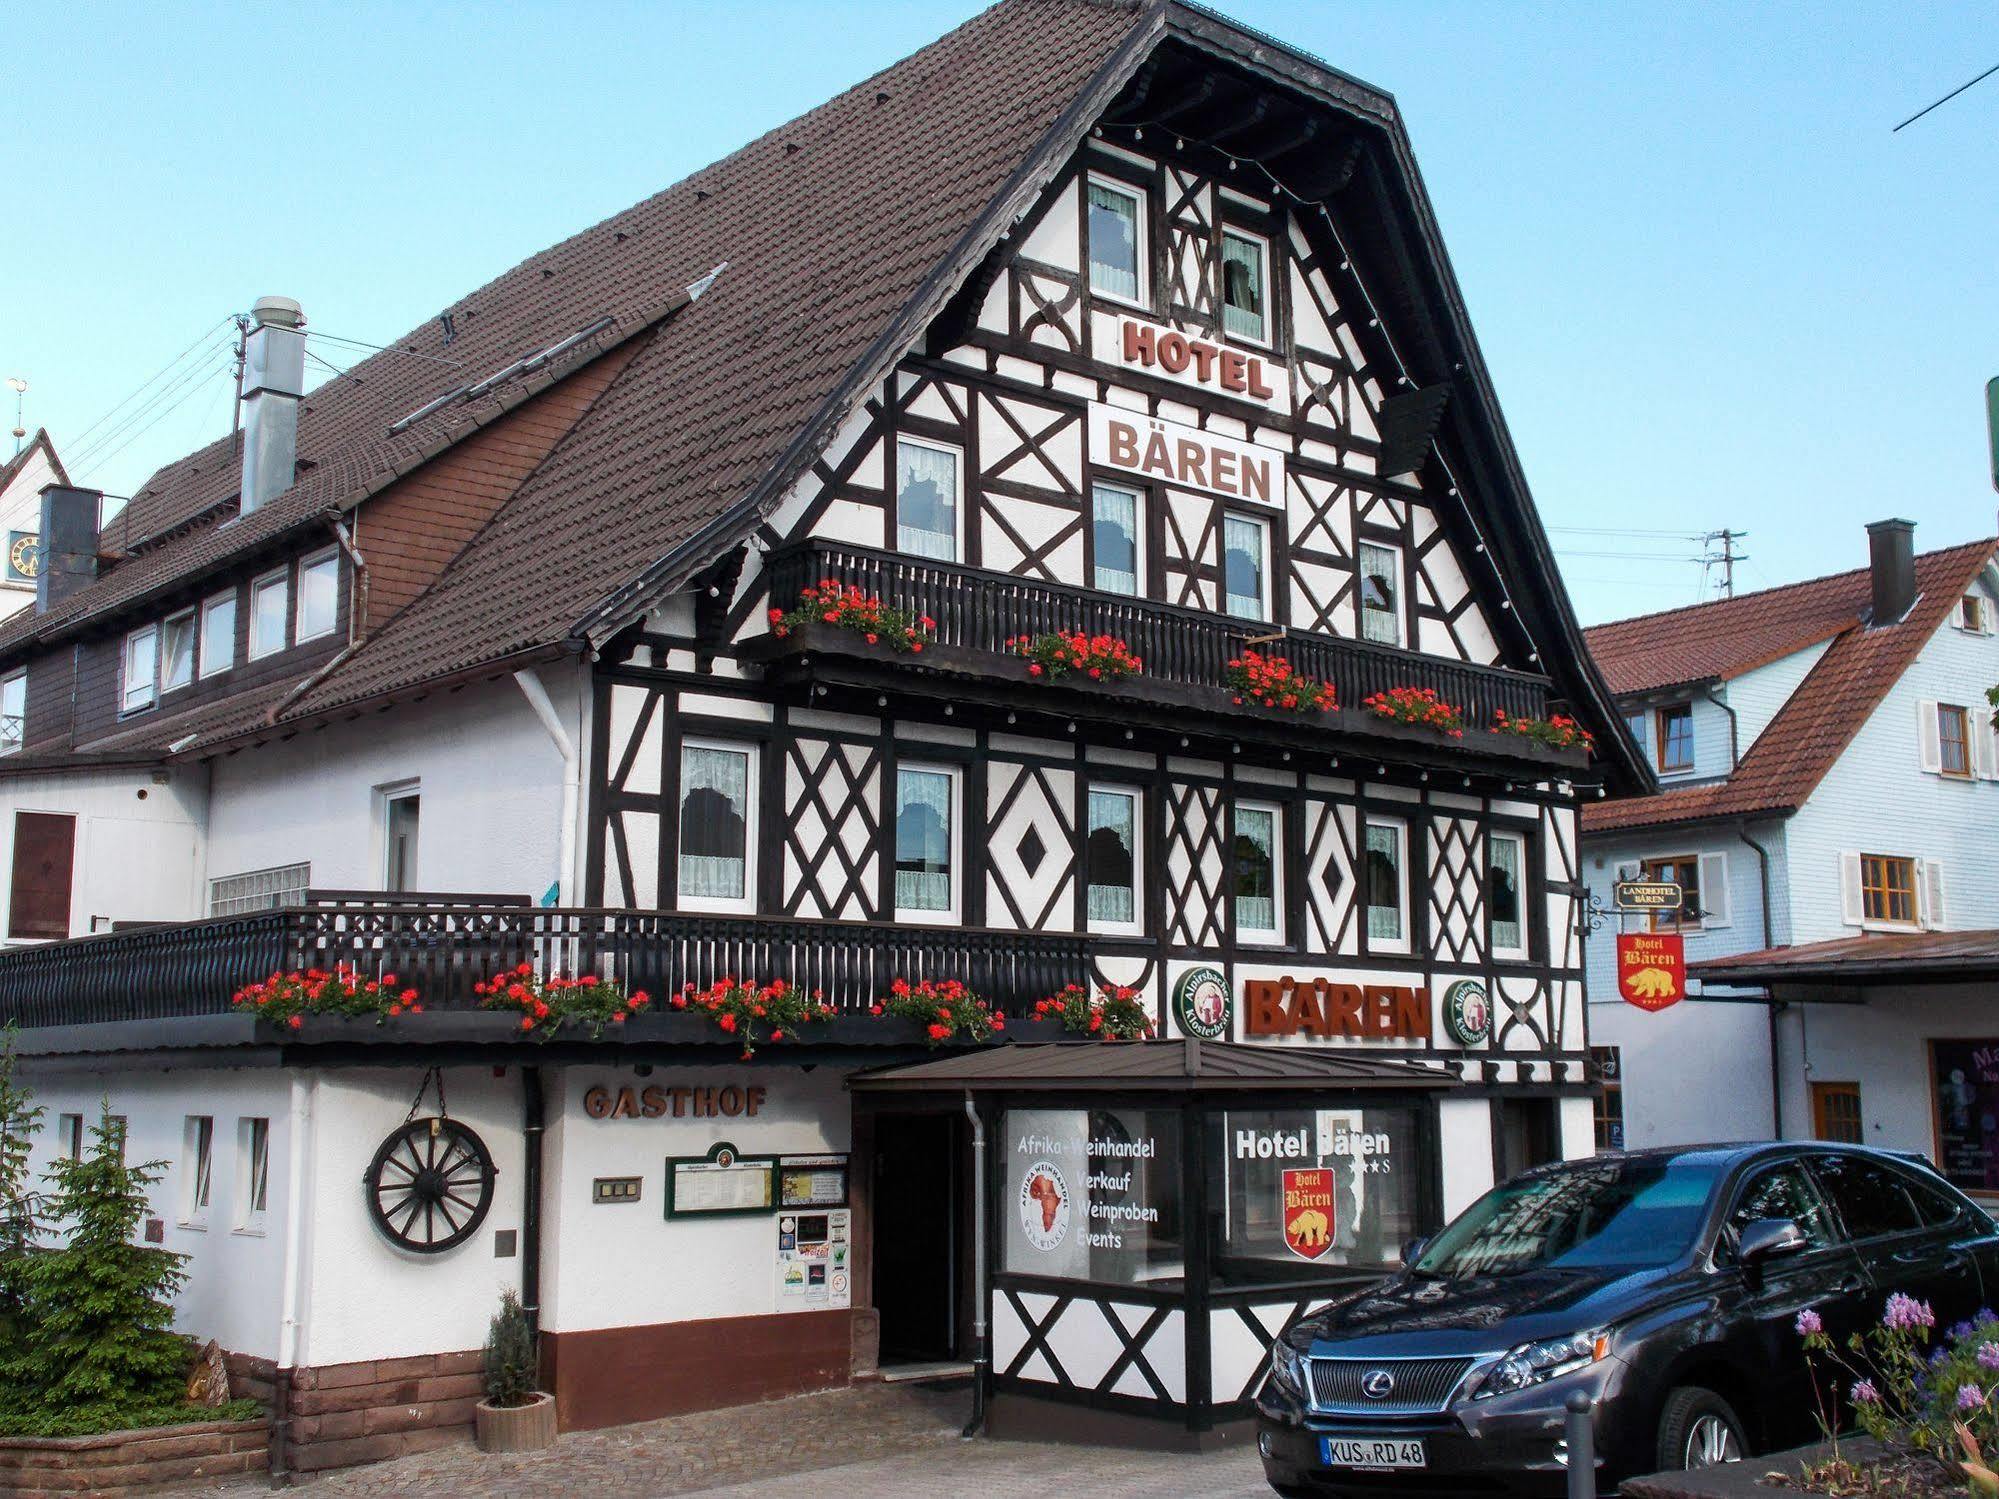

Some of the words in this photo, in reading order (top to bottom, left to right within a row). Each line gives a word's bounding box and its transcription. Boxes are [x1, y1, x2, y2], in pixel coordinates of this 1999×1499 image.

[1123, 320, 1273, 400] HOTEL
[1108, 421, 1271, 502] BÄREN
[1623, 887, 1676, 895] LANDHOTEL
[1635, 895, 1665, 903] BÄREN
[1635, 938, 1664, 950] Hotel
[1624, 950, 1675, 966] Bären
[1184, 969, 1231, 1002] Alpirsbacher
[1245, 975, 1431, 1038] BÄREN
[1185, 1008, 1231, 1037] Klosterbräu
[584, 1085, 767, 1119] GASTHOF
[1236, 1130, 1308, 1159] Hotel
[1077, 1170, 1131, 1191] Verkauf
[1295, 1172, 1321, 1187] Hotel
[1077, 1199, 1158, 1224] Weinproben
[1286, 1189, 1331, 1211] Bären
[1076, 1226, 1122, 1249] Events
[1330, 1442, 1363, 1463] KUS
[1373, 1443, 1397, 1463] RD
[1401, 1443, 1422, 1463] 48
